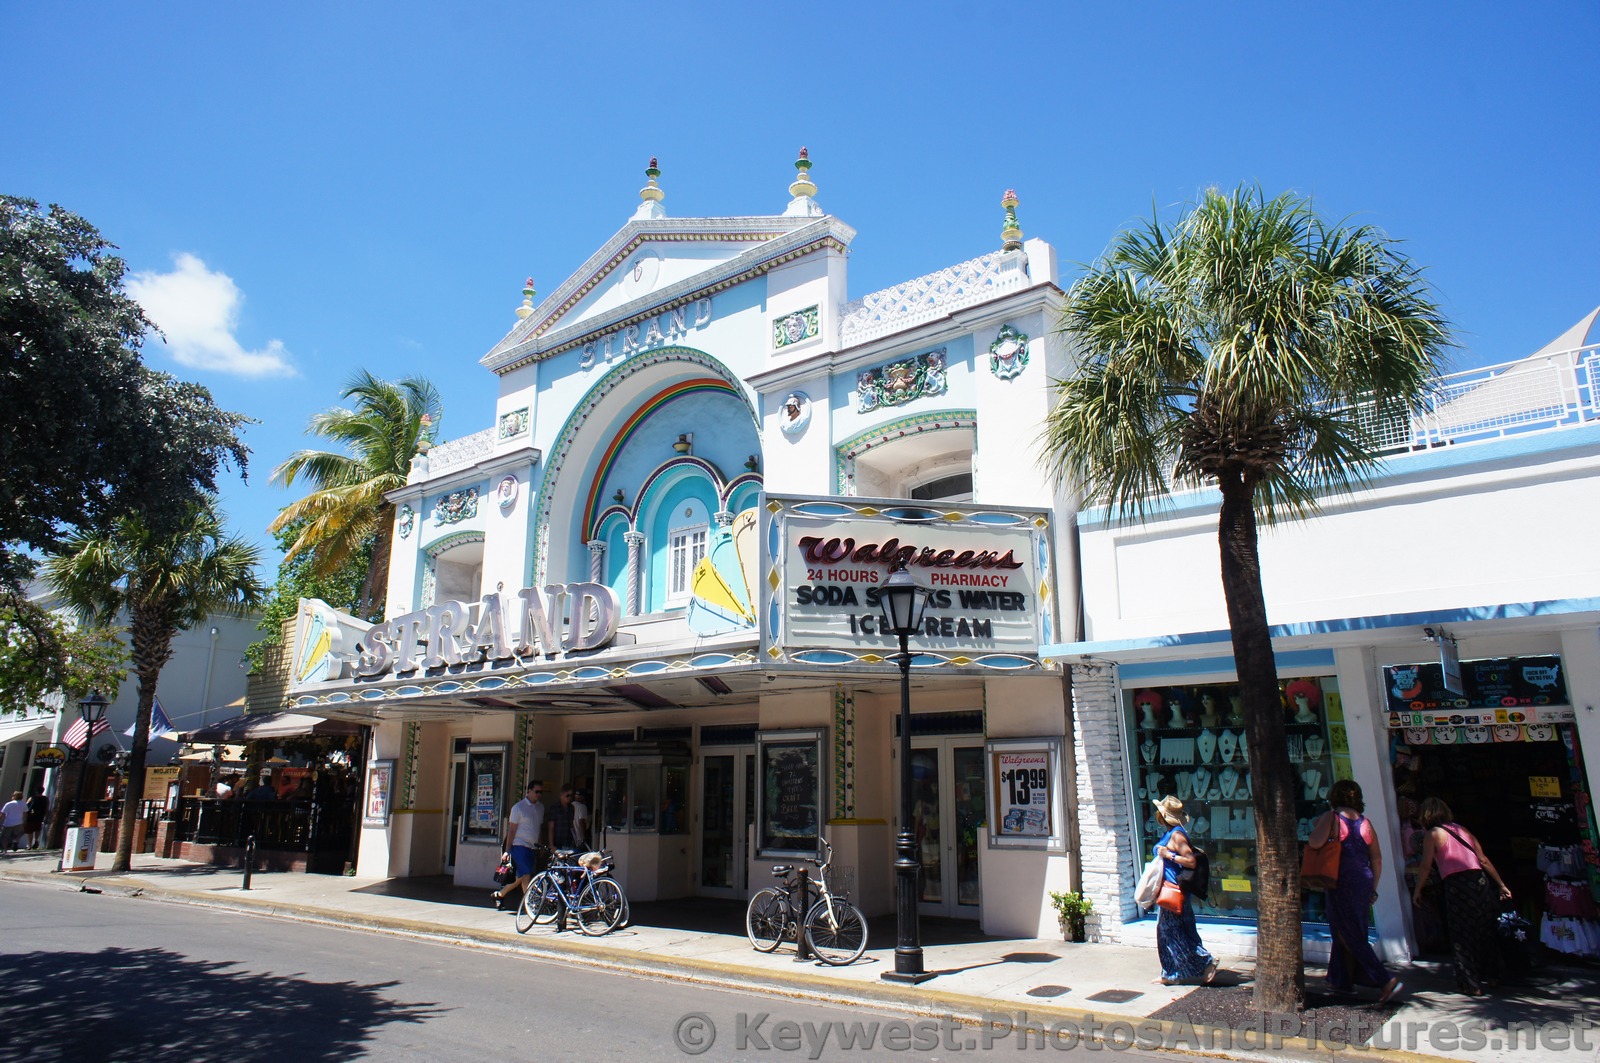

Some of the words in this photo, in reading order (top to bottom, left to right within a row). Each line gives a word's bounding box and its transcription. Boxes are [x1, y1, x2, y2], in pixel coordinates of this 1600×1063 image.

[578, 296, 713, 369] STRAND
[798, 536, 1024, 573] Walgreens
[807, 569, 824, 581] 24
[828, 569, 879, 583] HOURS
[931, 573, 1009, 587] PHARMACY
[796, 585, 859, 606] SODA
[956, 590, 1026, 611] WATER
[351, 582, 621, 679] STRAND
[850, 614, 893, 635] ICE
[1529, 723, 1551, 731] BRO
[1538, 731, 1545, 739] 5
[1001, 756, 1046, 767] Walgreens
